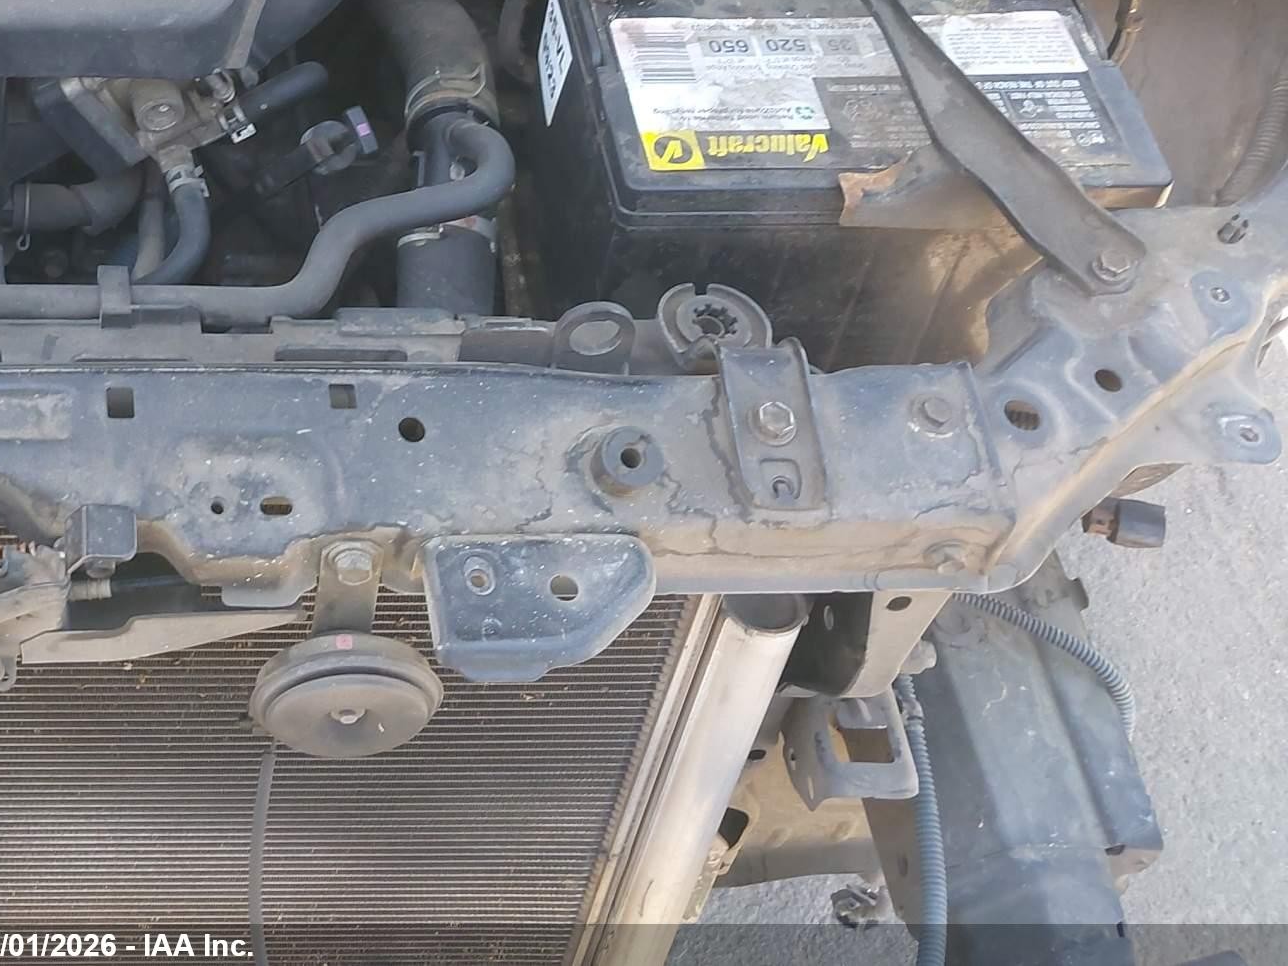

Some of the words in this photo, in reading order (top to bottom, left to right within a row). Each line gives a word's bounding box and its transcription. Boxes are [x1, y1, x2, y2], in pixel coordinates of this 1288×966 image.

[710, 39, 750, 54] 650
[765, 38, 807, 52] 520
[708, 132, 830, 163] Valucraft
